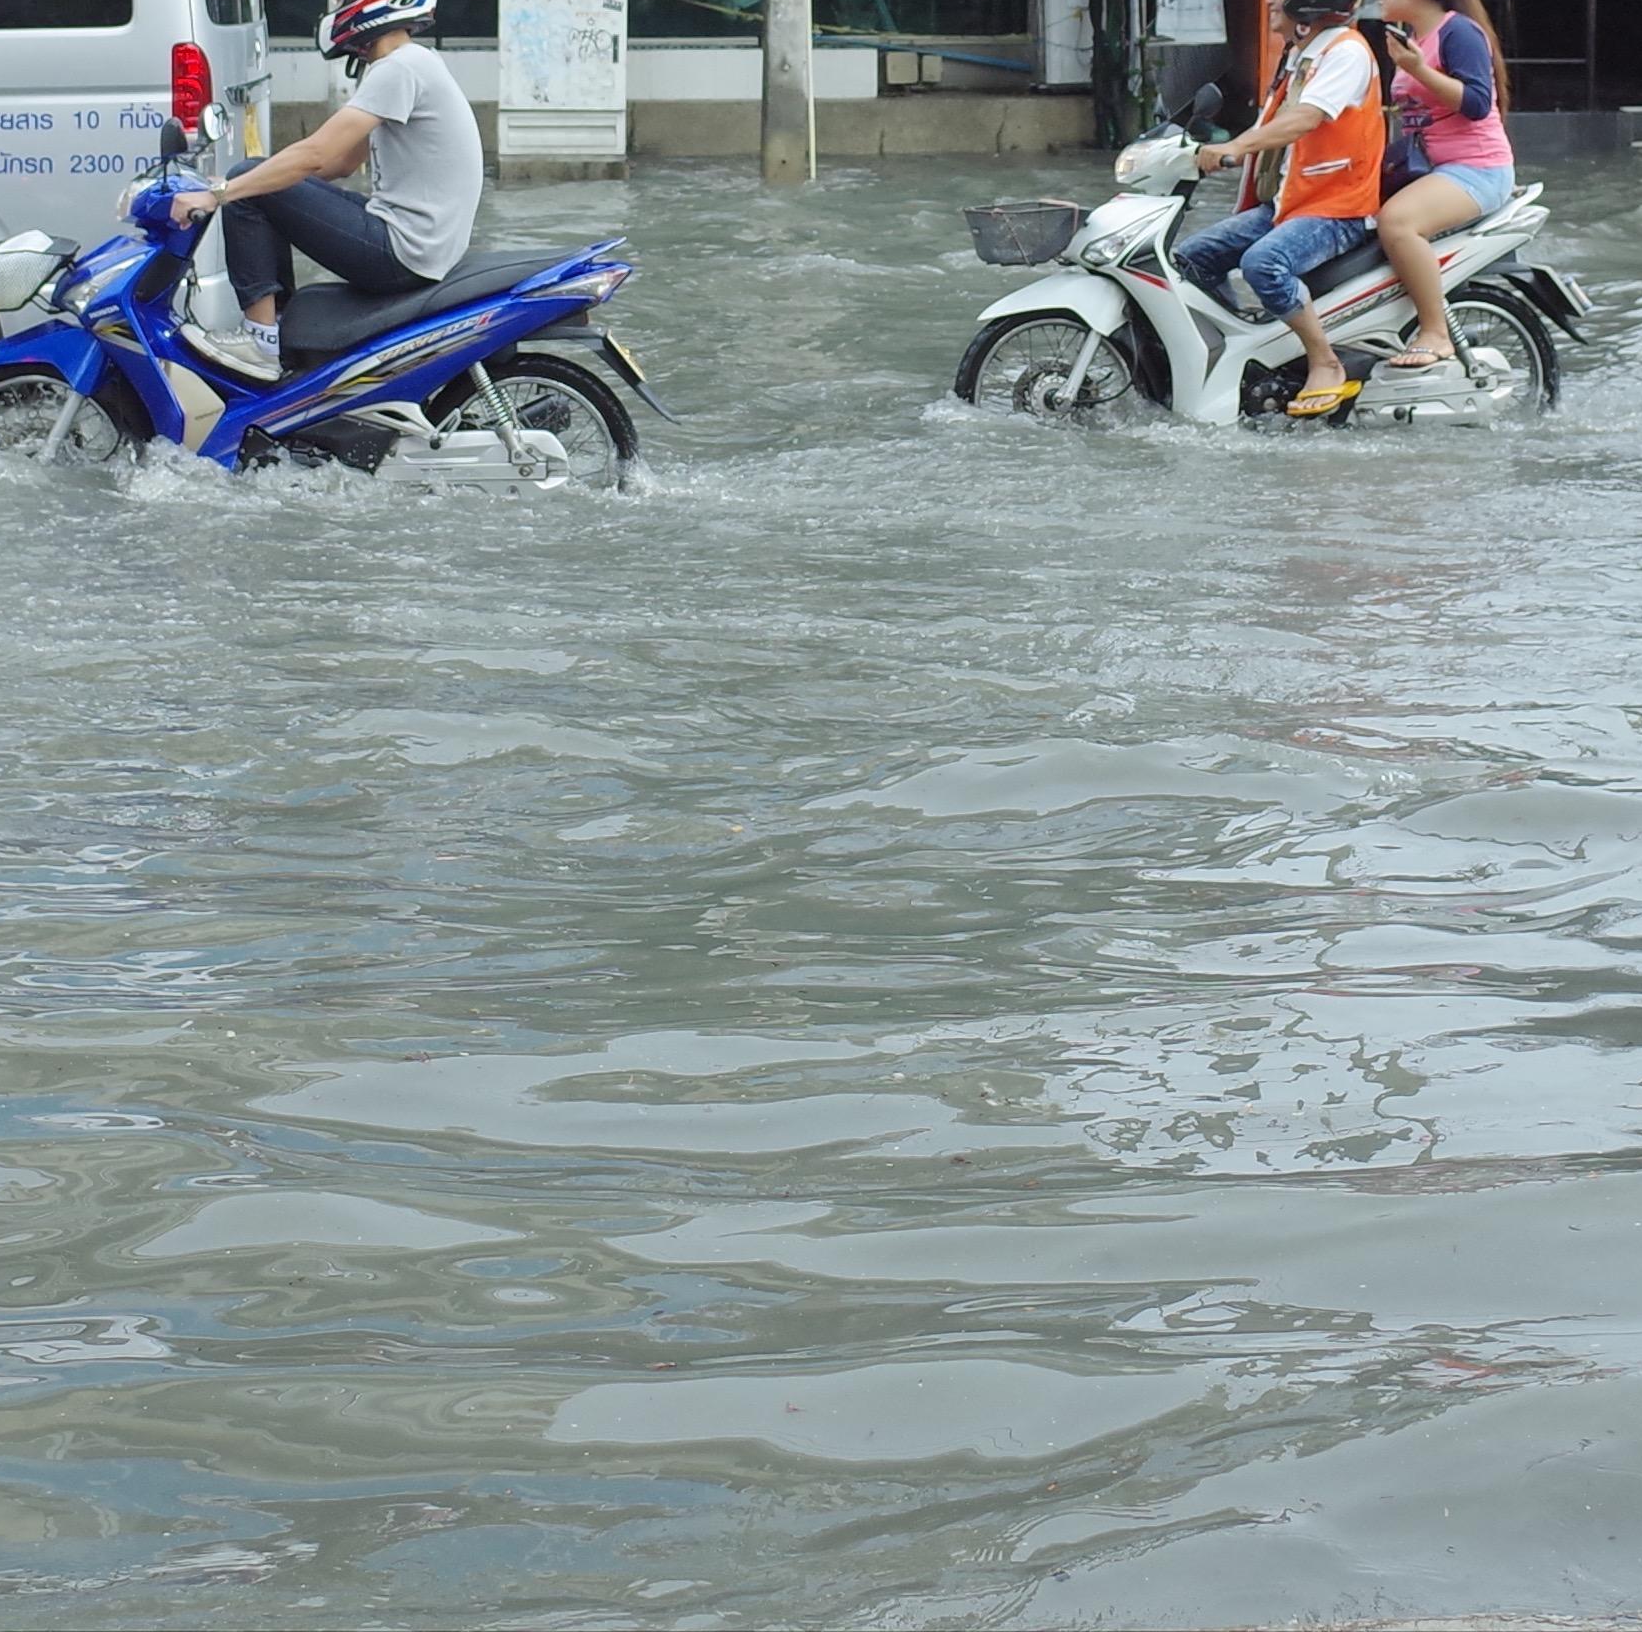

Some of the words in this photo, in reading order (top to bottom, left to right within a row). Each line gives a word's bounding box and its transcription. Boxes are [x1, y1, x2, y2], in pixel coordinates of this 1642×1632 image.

[73, 111, 100, 130] 10
[119, 102, 164, 129] ที่นั่ง
[70, 154, 125, 174] 2300
